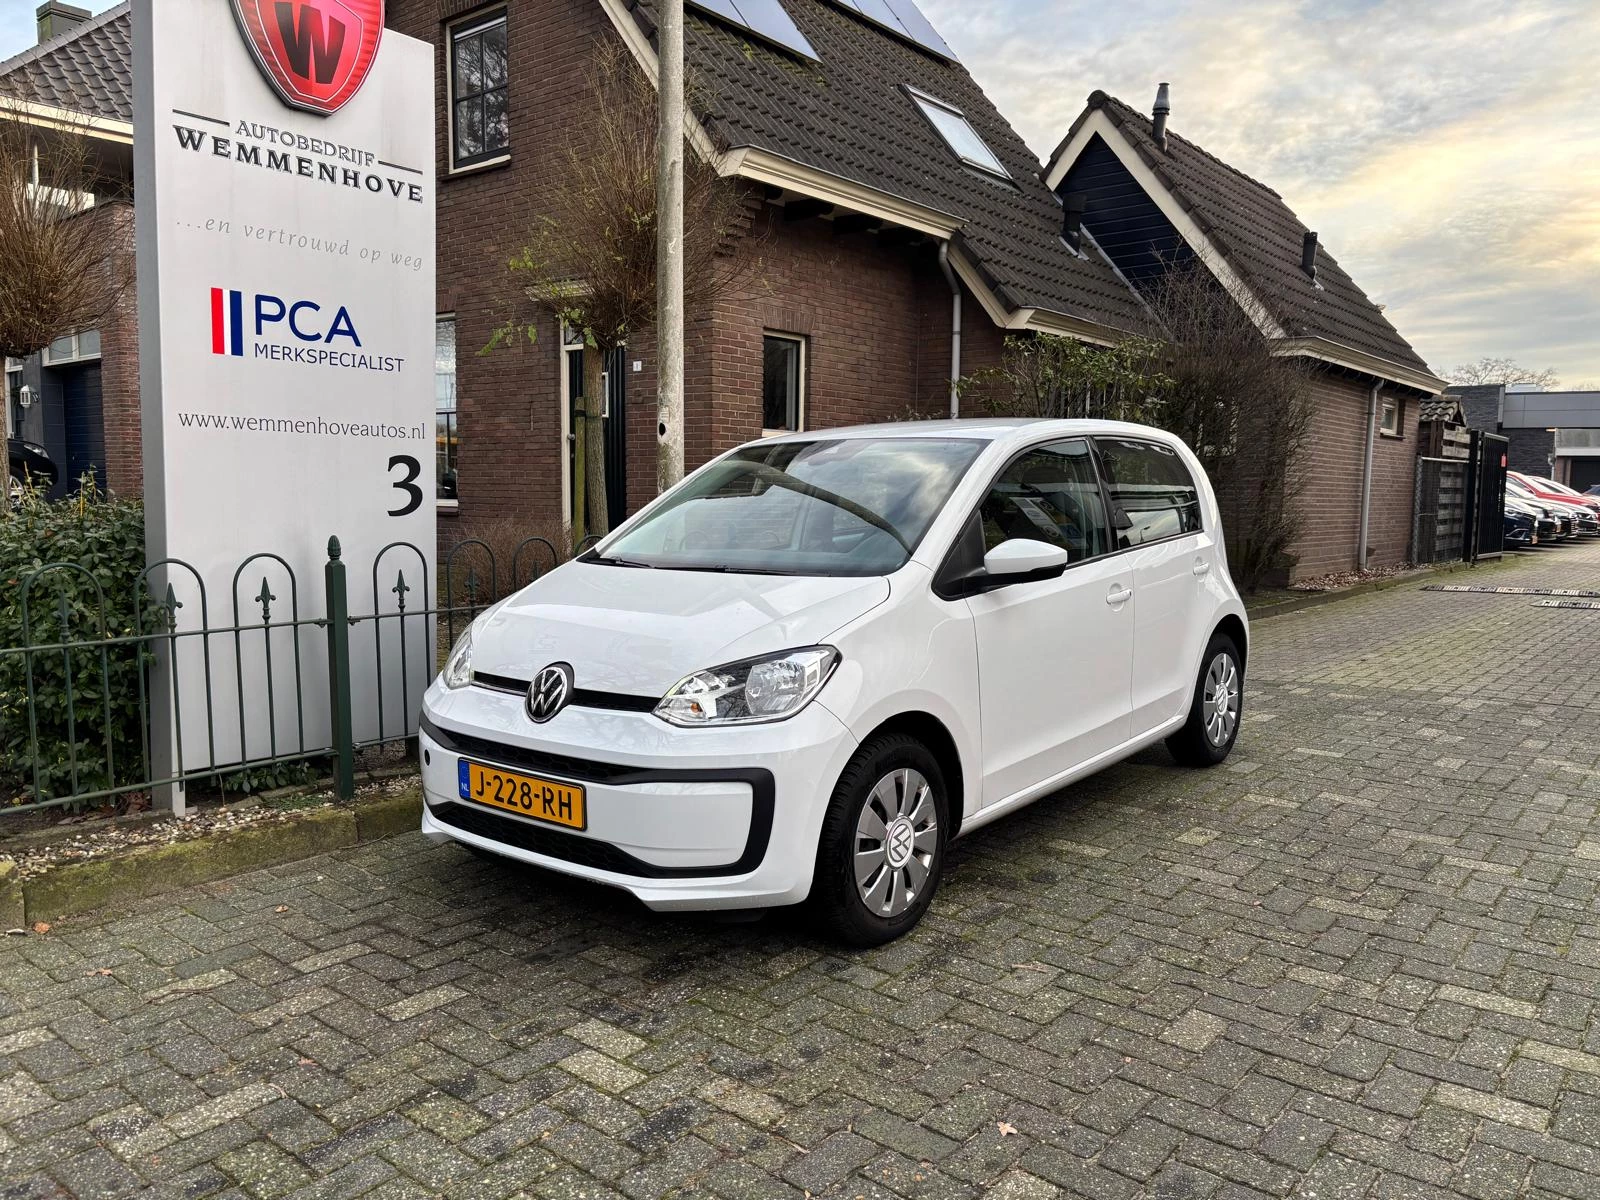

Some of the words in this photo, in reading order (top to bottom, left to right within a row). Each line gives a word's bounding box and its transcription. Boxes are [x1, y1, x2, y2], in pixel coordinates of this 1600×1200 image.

[274, 2, 346, 84] W
[172, 124, 424, 203] WEMMENHOVE
[235, 120, 375, 167] AUTOBEDRIJF
[244, 224, 350, 256] vertrouwd
[359, 247, 381, 263] op
[391, 253, 423, 271] weg
[254, 294, 362, 347] PCA
[254, 343, 405, 372] MERKSPECIALIST
[178, 412, 426, 440] www.wemmenhoveautos.nl
[387, 454, 424, 517] 3
[475, 770, 573, 821] J-228-RH
